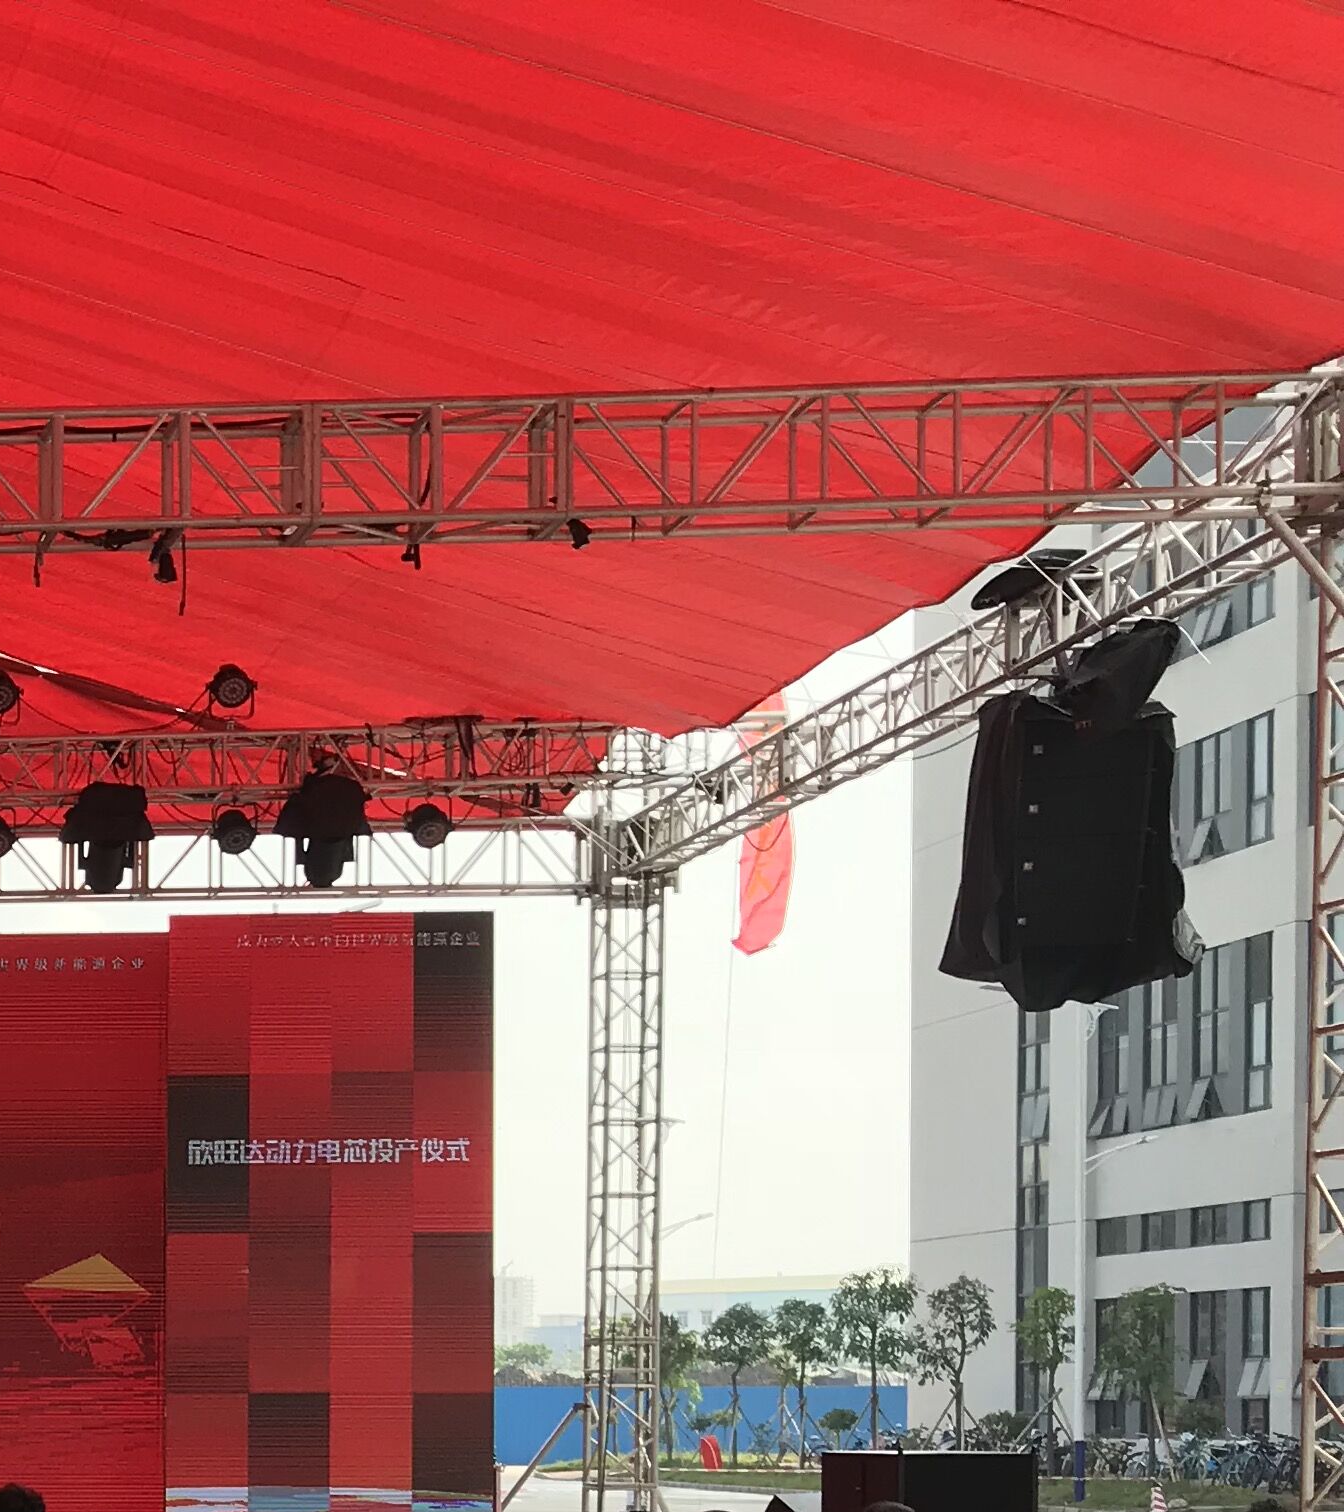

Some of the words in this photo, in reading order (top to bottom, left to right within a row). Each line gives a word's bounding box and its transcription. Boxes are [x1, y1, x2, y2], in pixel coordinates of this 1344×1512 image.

[187, 1137, 471, 1165] 欣旺达动力电芯投产仪式
